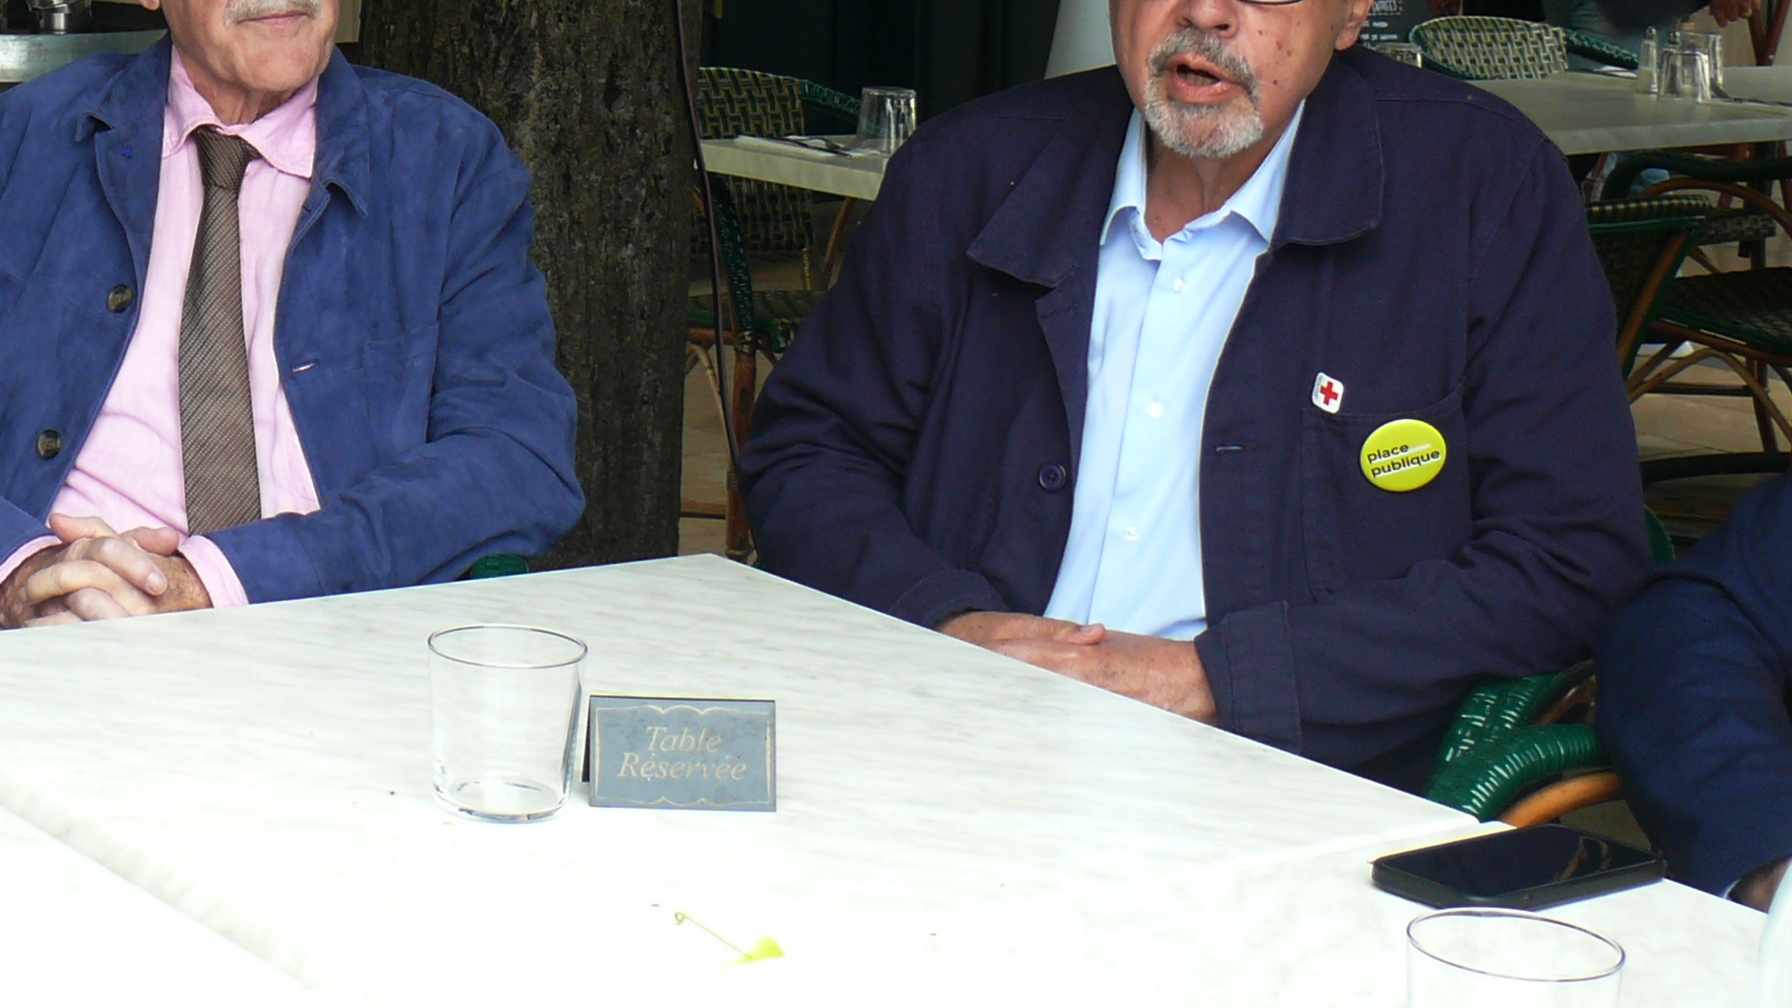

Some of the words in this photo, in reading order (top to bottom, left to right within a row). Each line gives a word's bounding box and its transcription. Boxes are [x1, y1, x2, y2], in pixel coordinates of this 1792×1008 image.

[1367, 443, 1409, 464] place
[1371, 450, 1441, 479] publique
[645, 726, 723, 753] Table
[617, 752, 748, 781] Réservée
